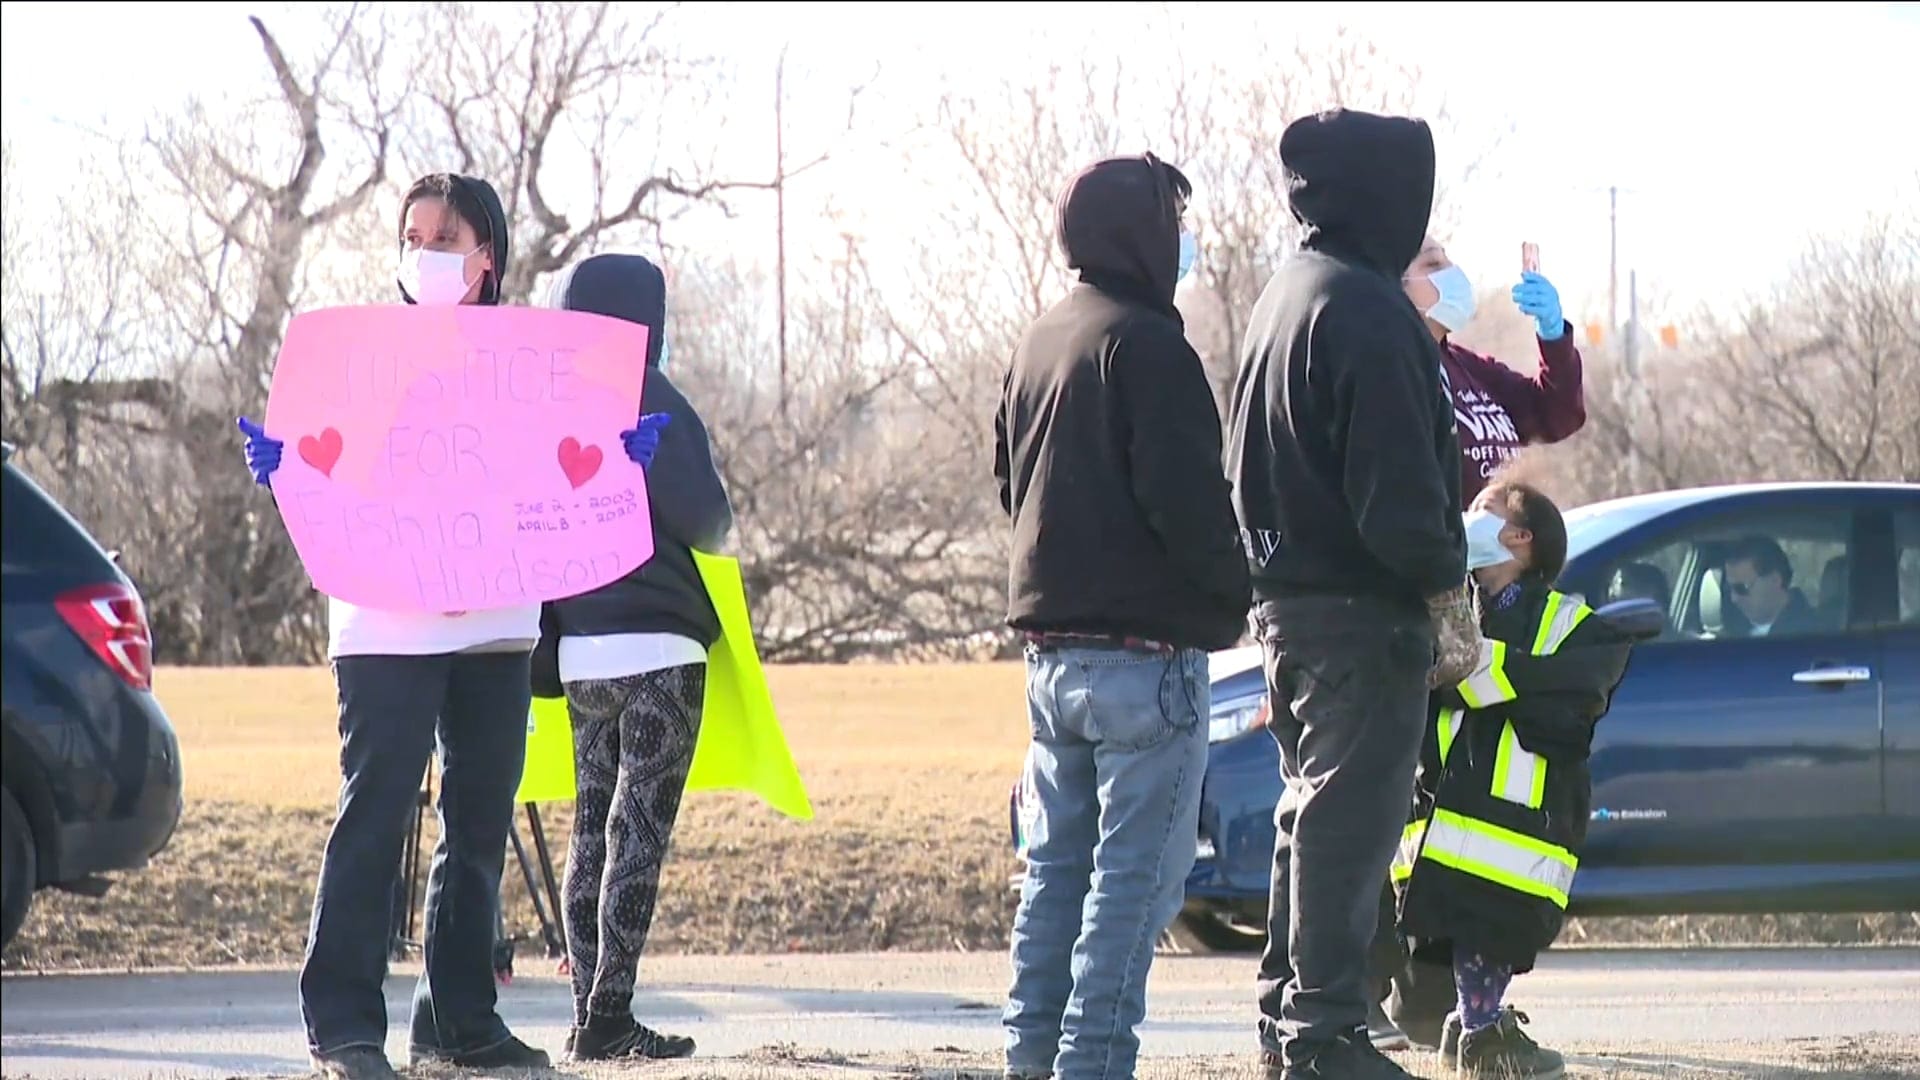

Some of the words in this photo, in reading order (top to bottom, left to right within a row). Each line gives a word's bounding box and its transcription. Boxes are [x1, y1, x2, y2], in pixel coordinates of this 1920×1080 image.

[320, 346, 579, 407] JUSTICE
[388, 424, 489, 479] FOR
[517, 520, 557, 532] APRIL
[410, 548, 621, 608] Hudson
